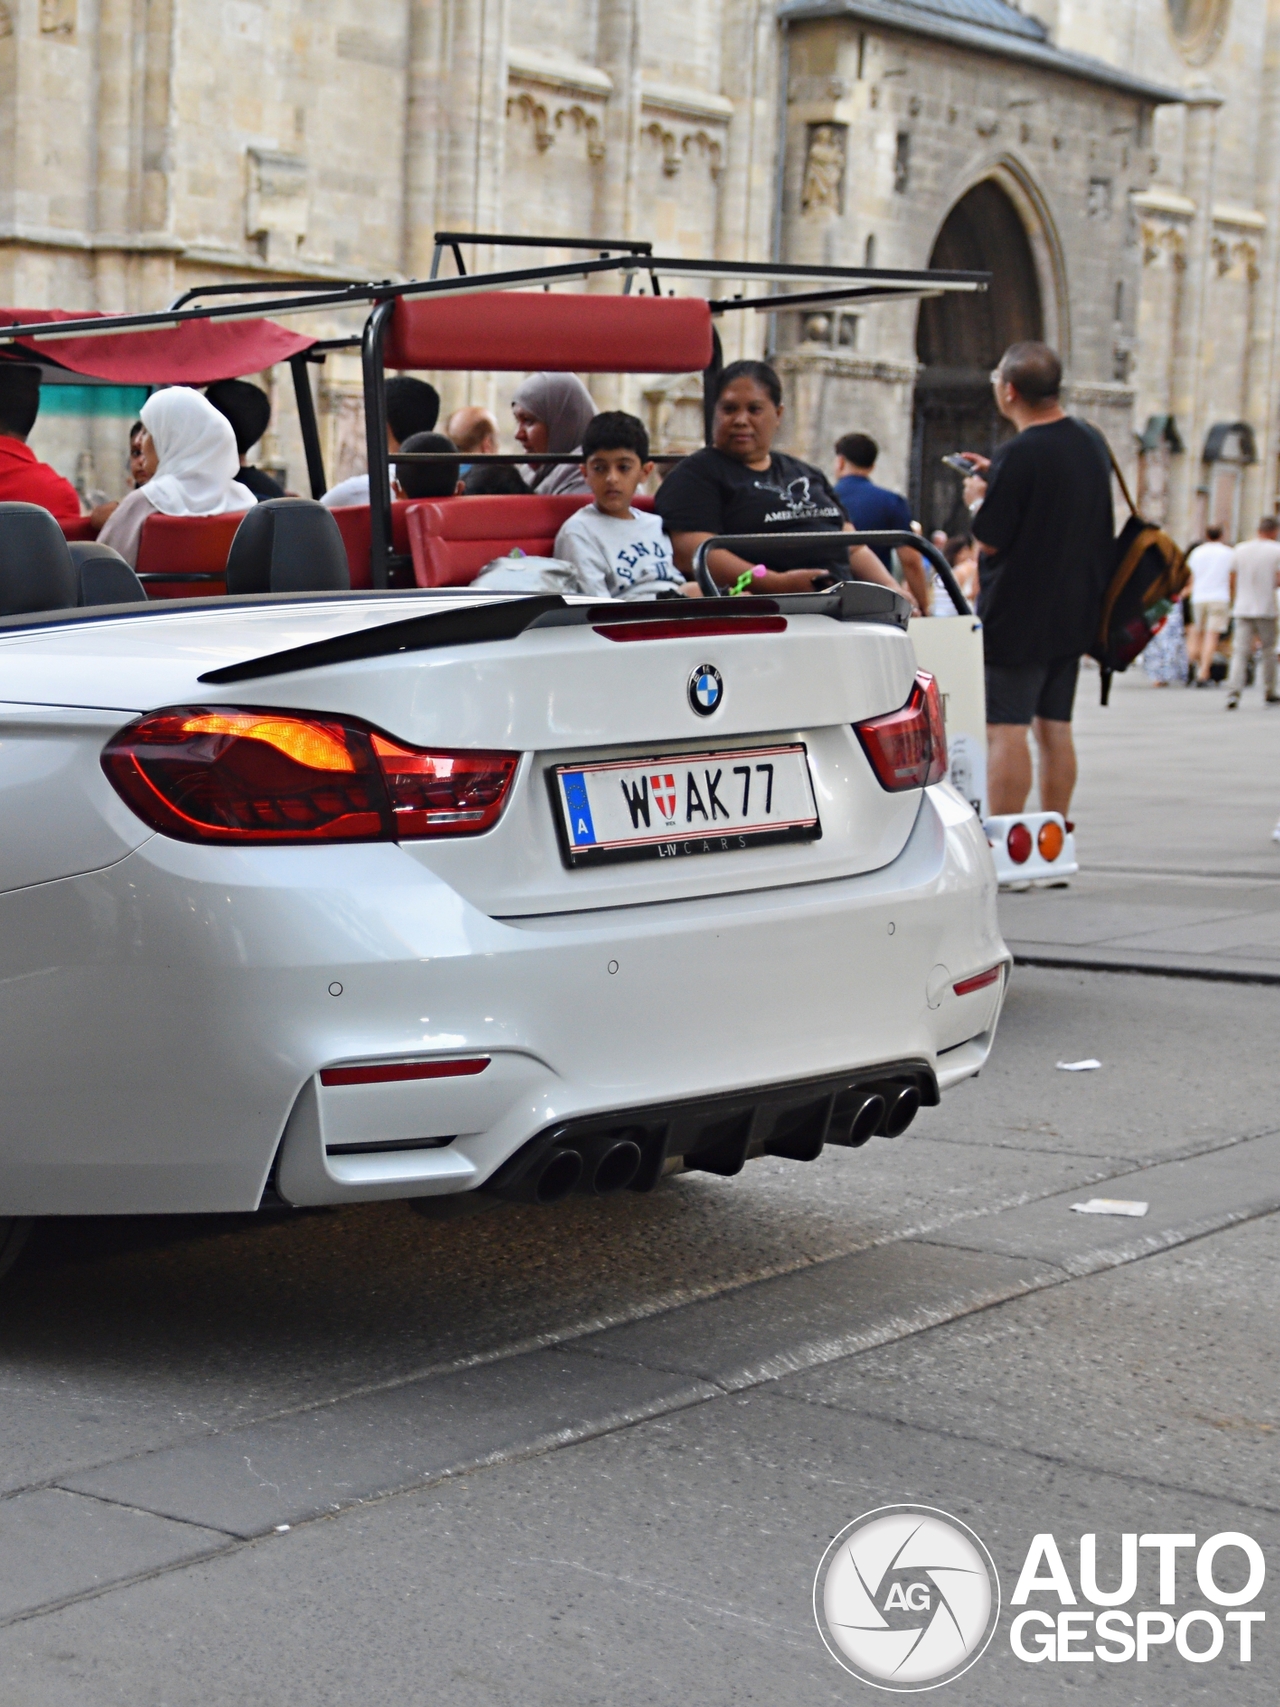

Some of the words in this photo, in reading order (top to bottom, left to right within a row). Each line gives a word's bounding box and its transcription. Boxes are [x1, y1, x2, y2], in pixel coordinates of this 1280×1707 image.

[616, 541, 666, 590] GEND
[620, 775, 651, 829] W
[577, 818, 589, 835] A
[683, 835, 747, 854] CARS
